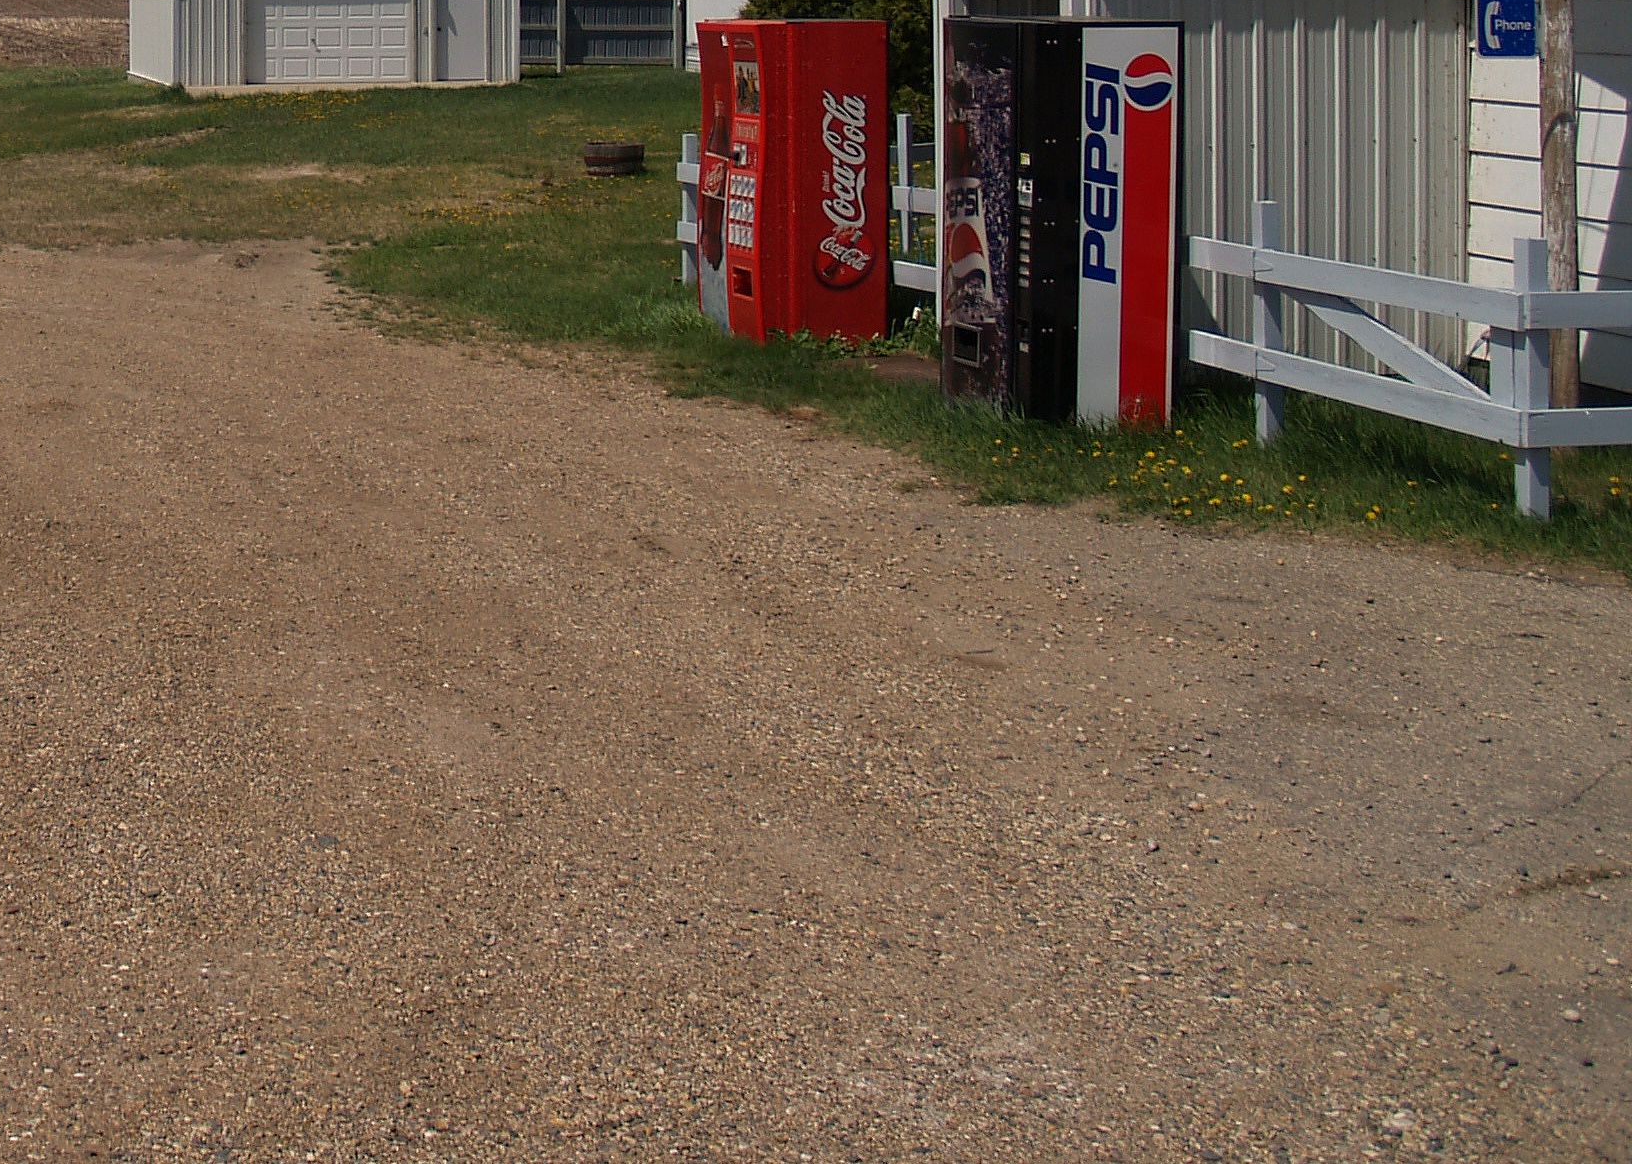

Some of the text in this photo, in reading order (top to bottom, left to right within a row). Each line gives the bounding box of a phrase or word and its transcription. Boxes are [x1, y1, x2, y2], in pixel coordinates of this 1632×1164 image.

[1495, 19, 1532, 31] Phone
[821, 89, 867, 229] Coca-Cola
[1082, 62, 1120, 285] PEPSI
